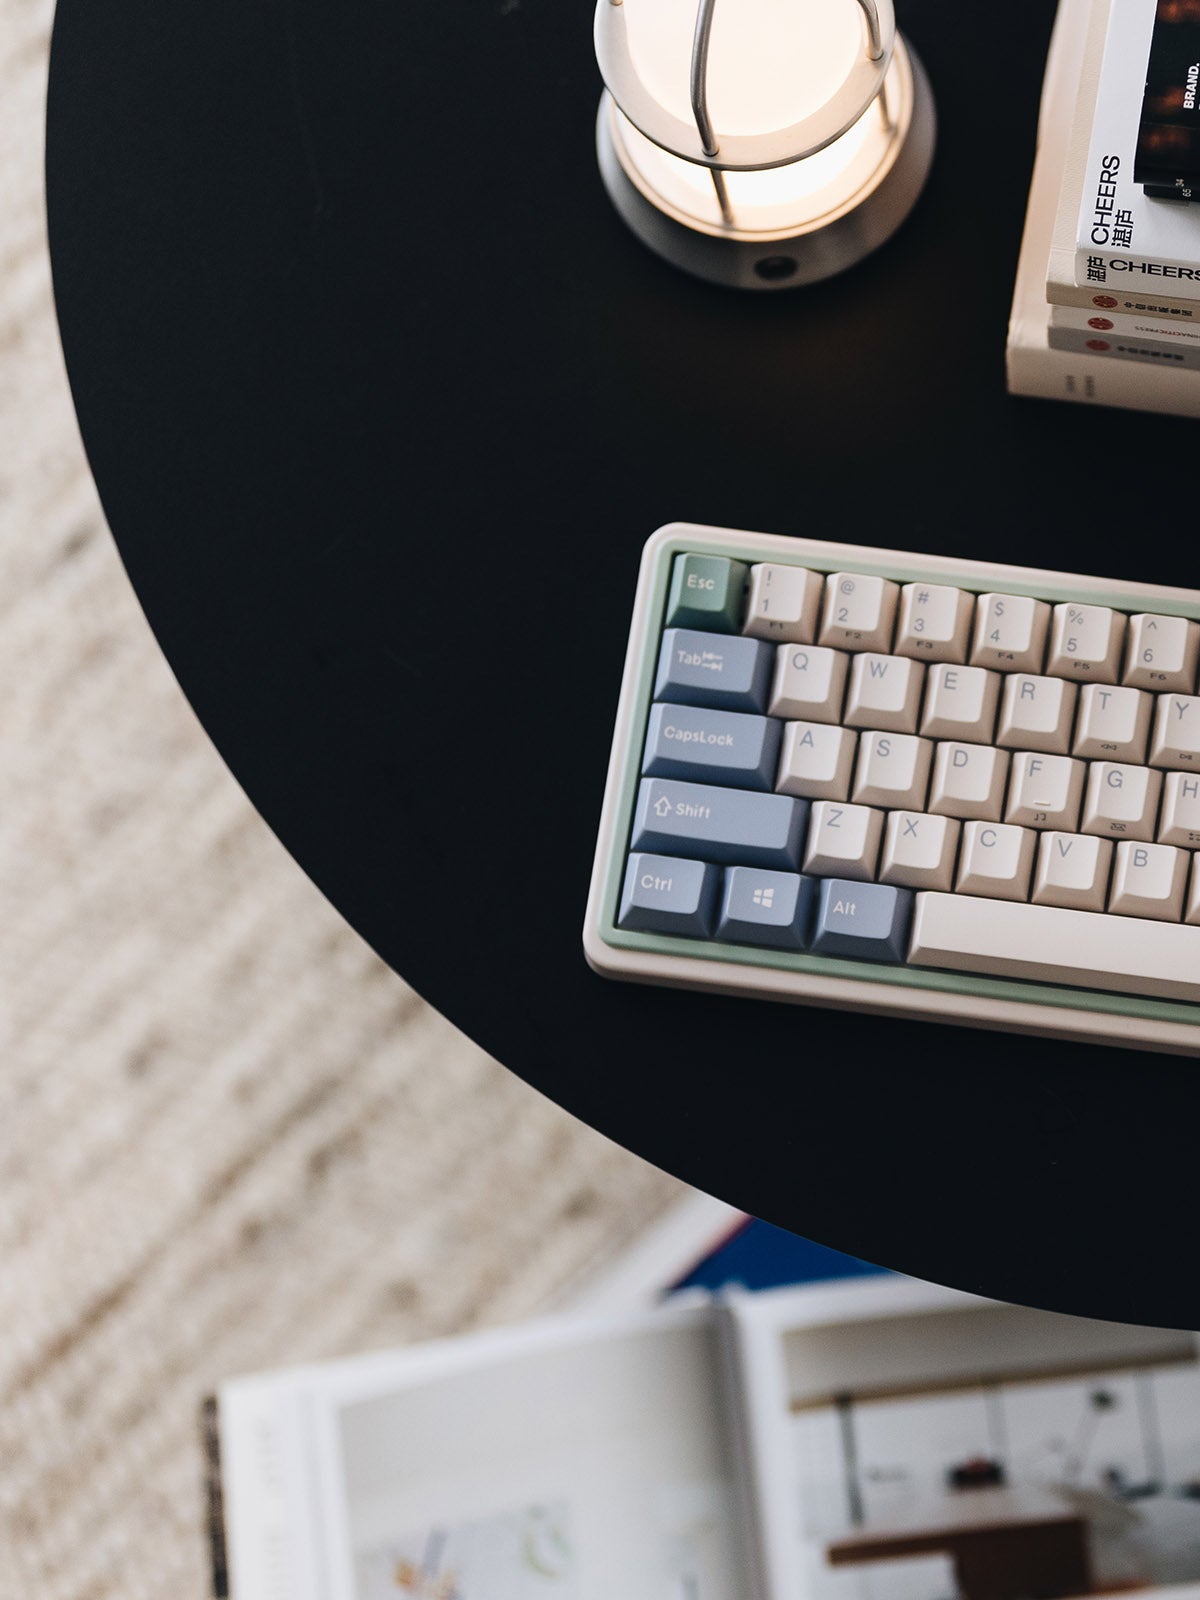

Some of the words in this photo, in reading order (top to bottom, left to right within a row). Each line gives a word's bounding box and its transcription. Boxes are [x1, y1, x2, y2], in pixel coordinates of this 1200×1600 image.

[1183, 62, 1200, 110] BRAND.
[1091, 155, 1120, 245] CHEERS
[1182, 188, 1192, 198] 65
[1111, 209, 1134, 248] 湛庐
[1087, 255, 1107, 283] 湛庐
[686, 574, 715, 591] Esc
[762, 599, 769, 612] 1
[838, 608, 848, 622] 2
[769, 621, 784, 630] F1
[914, 618, 925, 632] 3
[846, 631, 862, 640] F2
[991, 629, 1000, 642] 4
[916, 641, 933, 649] F3
[1067, 638, 1077, 652] 5
[677, 650, 701, 666] Tab
[792, 653, 808, 671] Q
[998, 652, 1014, 661] F4
[1143, 649, 1153, 663] 6
[870, 661, 888, 679] W
[1074, 661, 1090, 670] F5
[944, 672, 958, 690] E
[1150, 672, 1166, 681] F6
[1020, 682, 1036, 700] R
[1099, 692, 1111, 710] T
[1176, 702, 1189, 720] Y
[664, 726, 734, 746] CapsLock
[800, 731, 814, 748] A
[877, 740, 890, 757] S
[953, 750, 968, 767] D
[1029, 760, 1043, 777] F
[1107, 771, 1123, 789] G
[1182, 781, 1198, 799] H
[675, 803, 710, 819] Shift
[827, 809, 843, 828] Z
[903, 819, 919, 837] X
[980, 830, 997, 848] C
[1058, 839, 1073, 858] V
[1133, 849, 1149, 867] B
[641, 875, 673, 891] Ctrl
[833, 900, 856, 916] Alt
